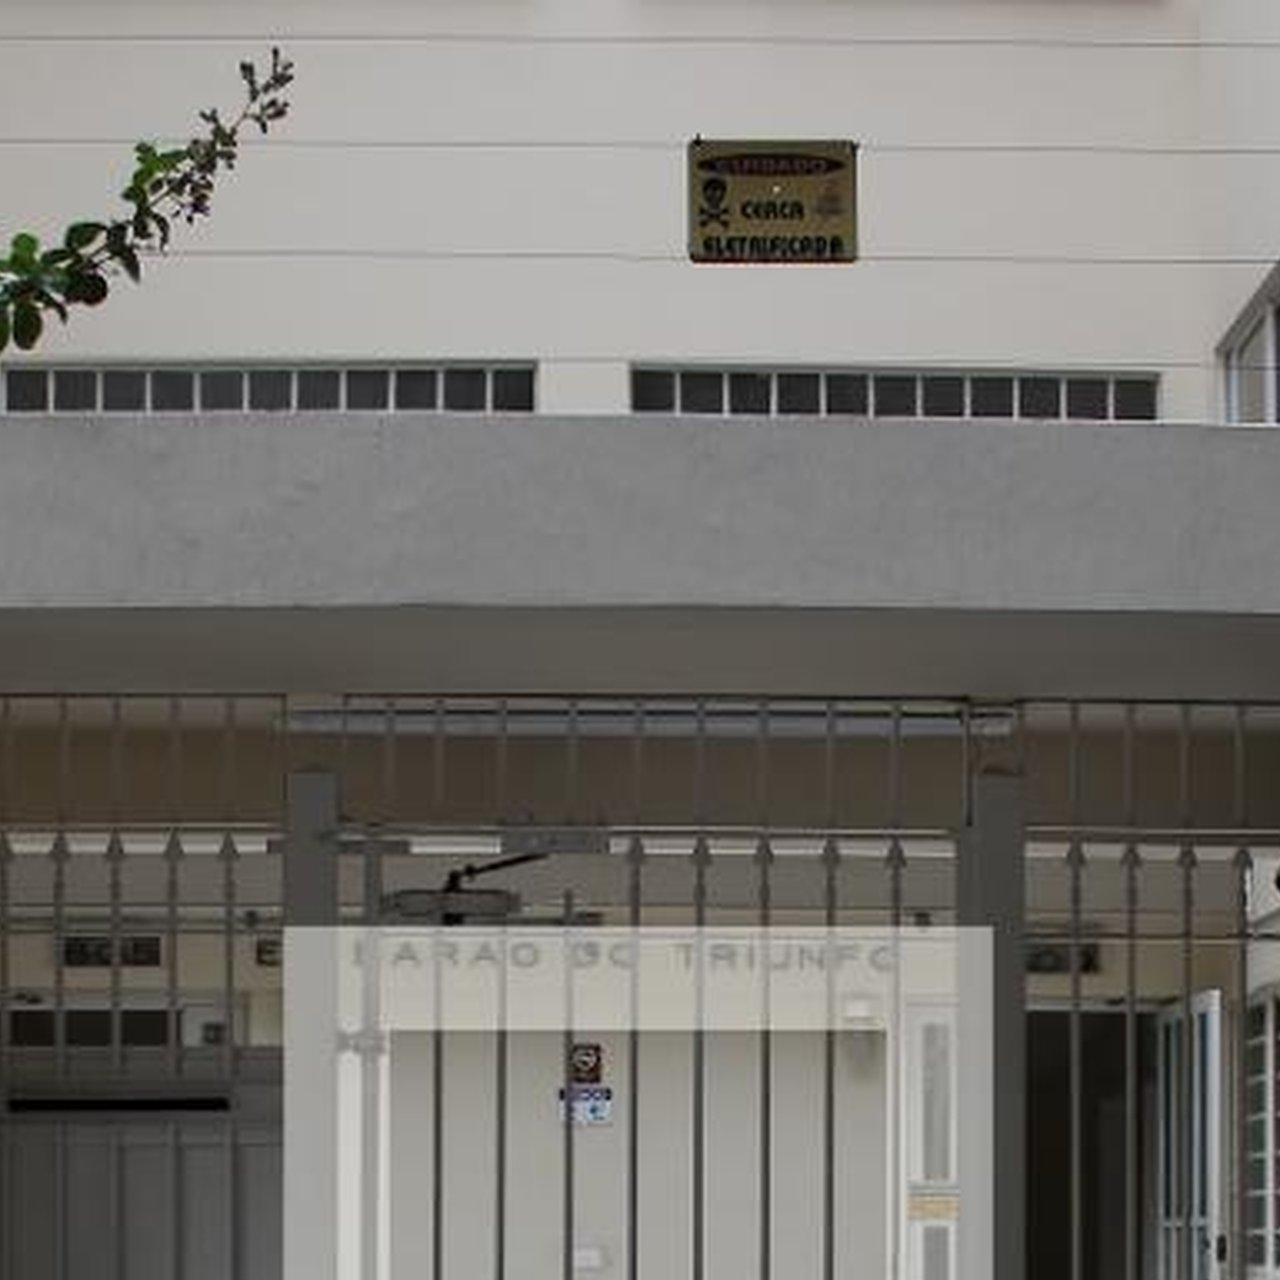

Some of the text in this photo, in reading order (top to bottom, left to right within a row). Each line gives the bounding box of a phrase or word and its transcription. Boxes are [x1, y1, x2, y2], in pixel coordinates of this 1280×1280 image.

[716, 158, 827, 173] CUIDADO
[741, 201, 805, 220] CERCA
[703, 236, 844, 255] ELETRIFICADA
